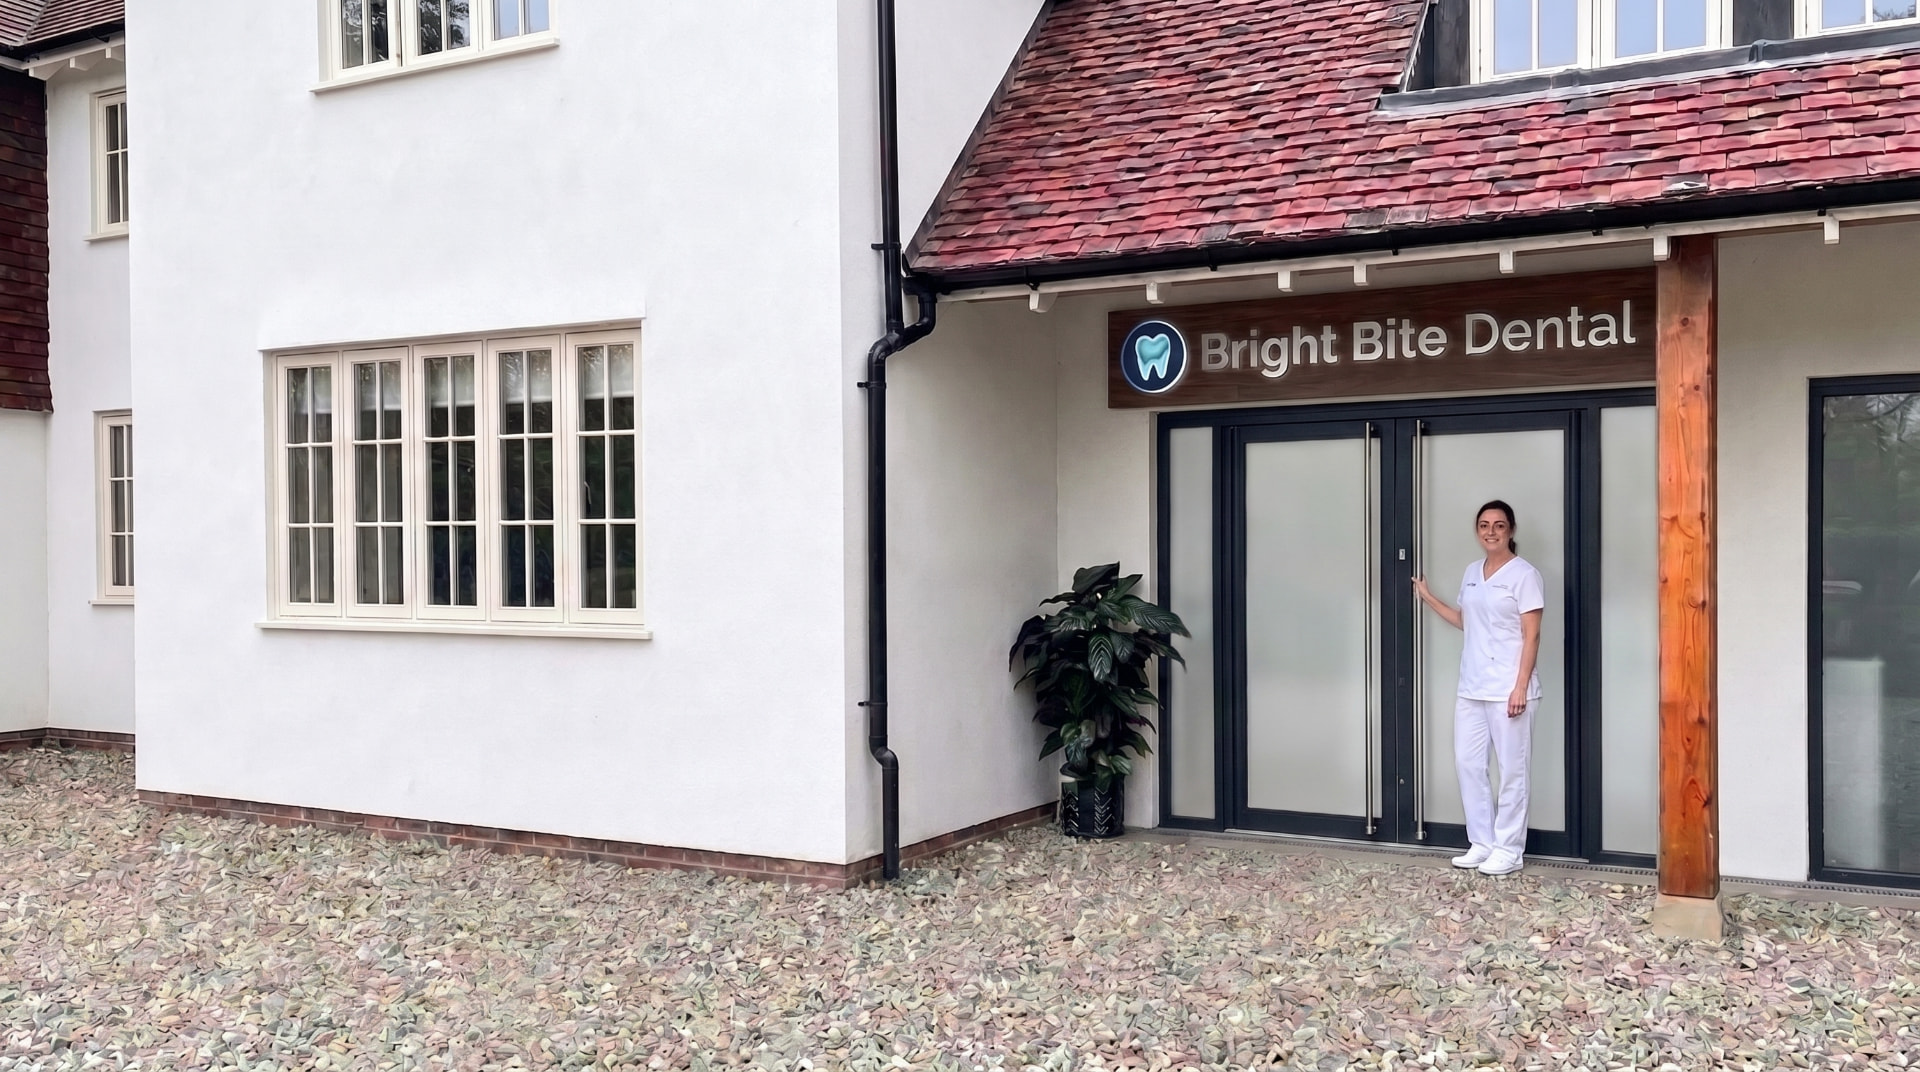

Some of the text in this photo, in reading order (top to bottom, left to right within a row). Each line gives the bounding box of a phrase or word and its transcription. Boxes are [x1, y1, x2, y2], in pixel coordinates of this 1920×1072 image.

[1201, 300, 1637, 378] Bright Bite Dental
